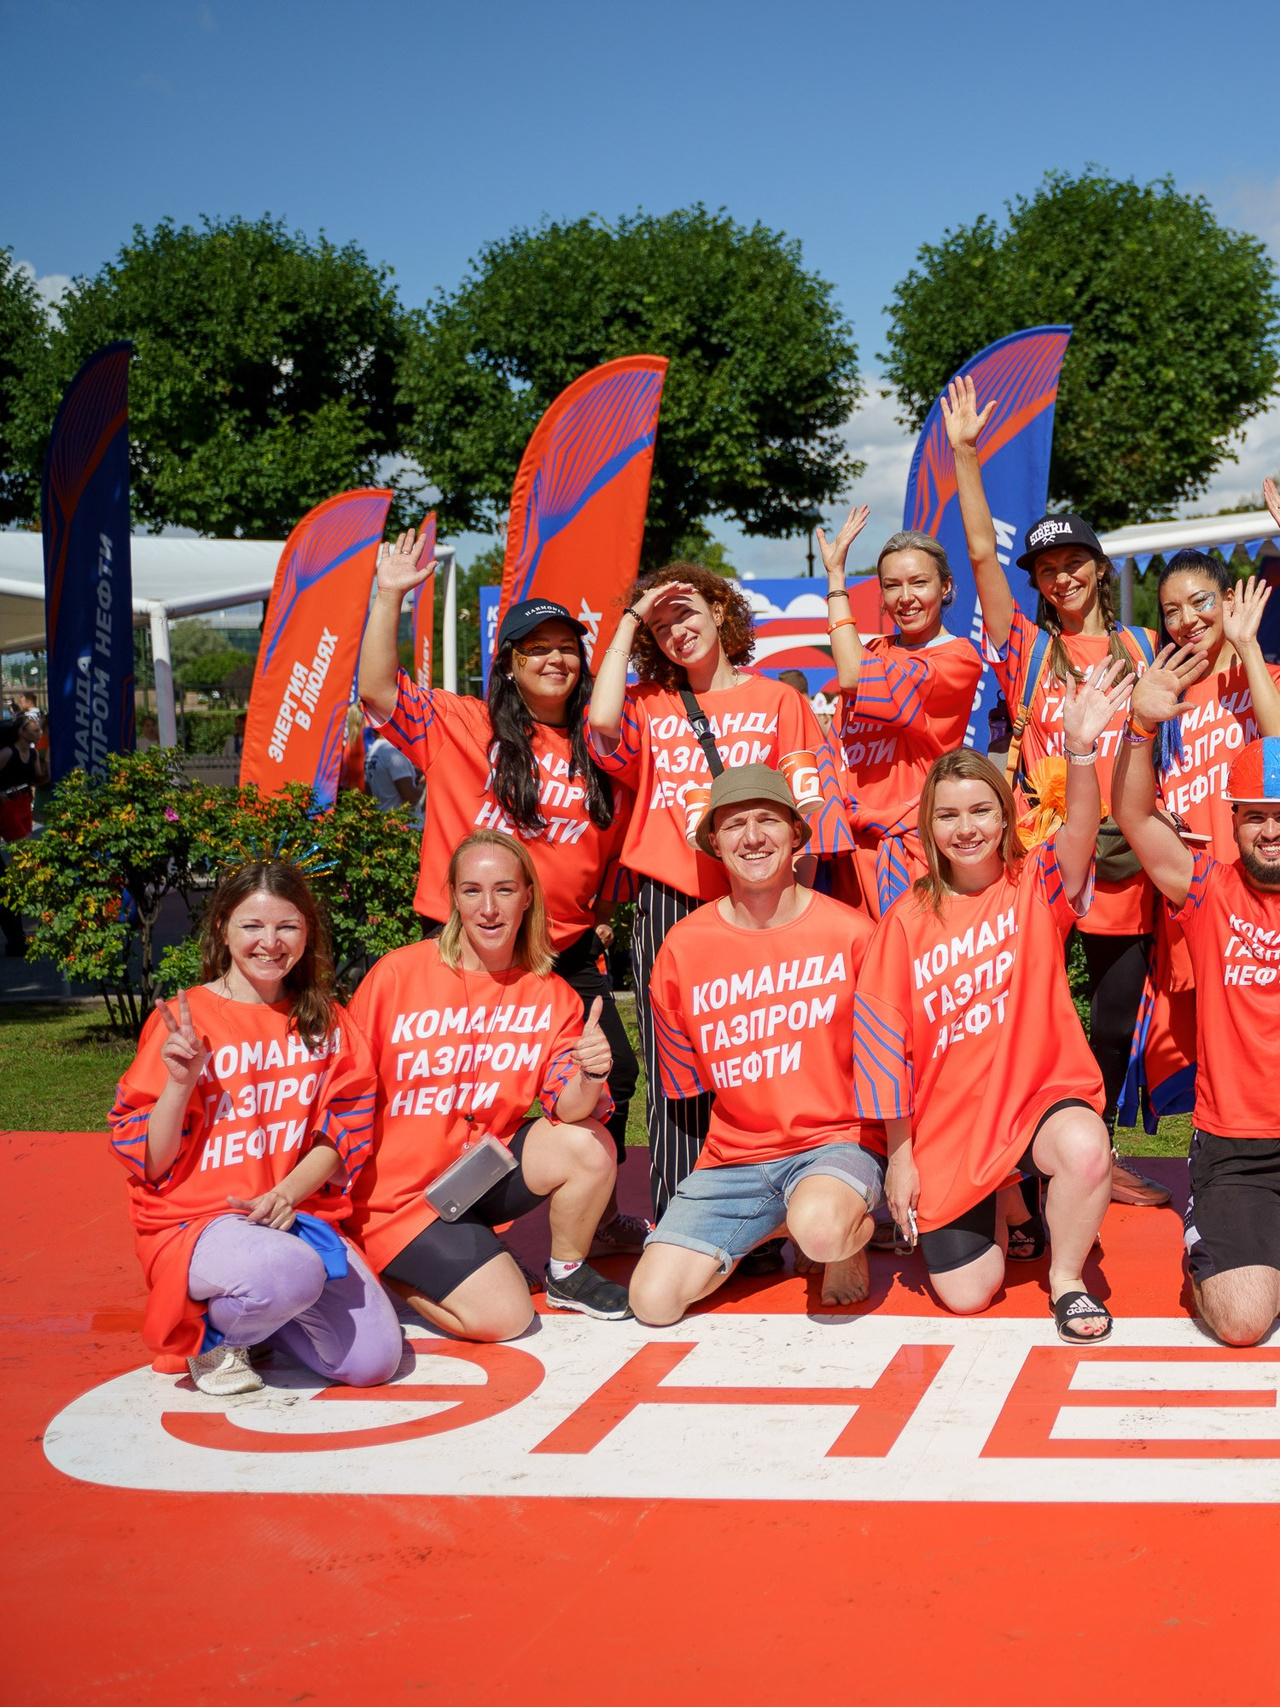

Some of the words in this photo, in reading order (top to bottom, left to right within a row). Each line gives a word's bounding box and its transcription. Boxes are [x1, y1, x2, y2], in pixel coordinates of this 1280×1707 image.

[1030, 522, 1073, 546] SIBERIA
[95, 531, 113, 658] НЕФТИ
[301, 626, 339, 714] ЛЮДЯХ
[268, 660, 309, 763] ЭНЕРГИЯ
[294, 709, 311, 731] В
[693, 952, 847, 1016] КОМАНДА
[391, 1004, 552, 1044] КОМАНДА
[700, 994, 837, 1054] ГАЗПРОМ
[396, 1042, 542, 1081] ГАЗПРОМ
[711, 1041, 802, 1089] НЕФТИ
[204, 1071, 329, 1129] ГАЗПРО
[390, 1082, 500, 1117] НЕФТИ
[200, 1117, 308, 1172] НЕФТИ
[1066, 1306, 1106, 1316] adidas
